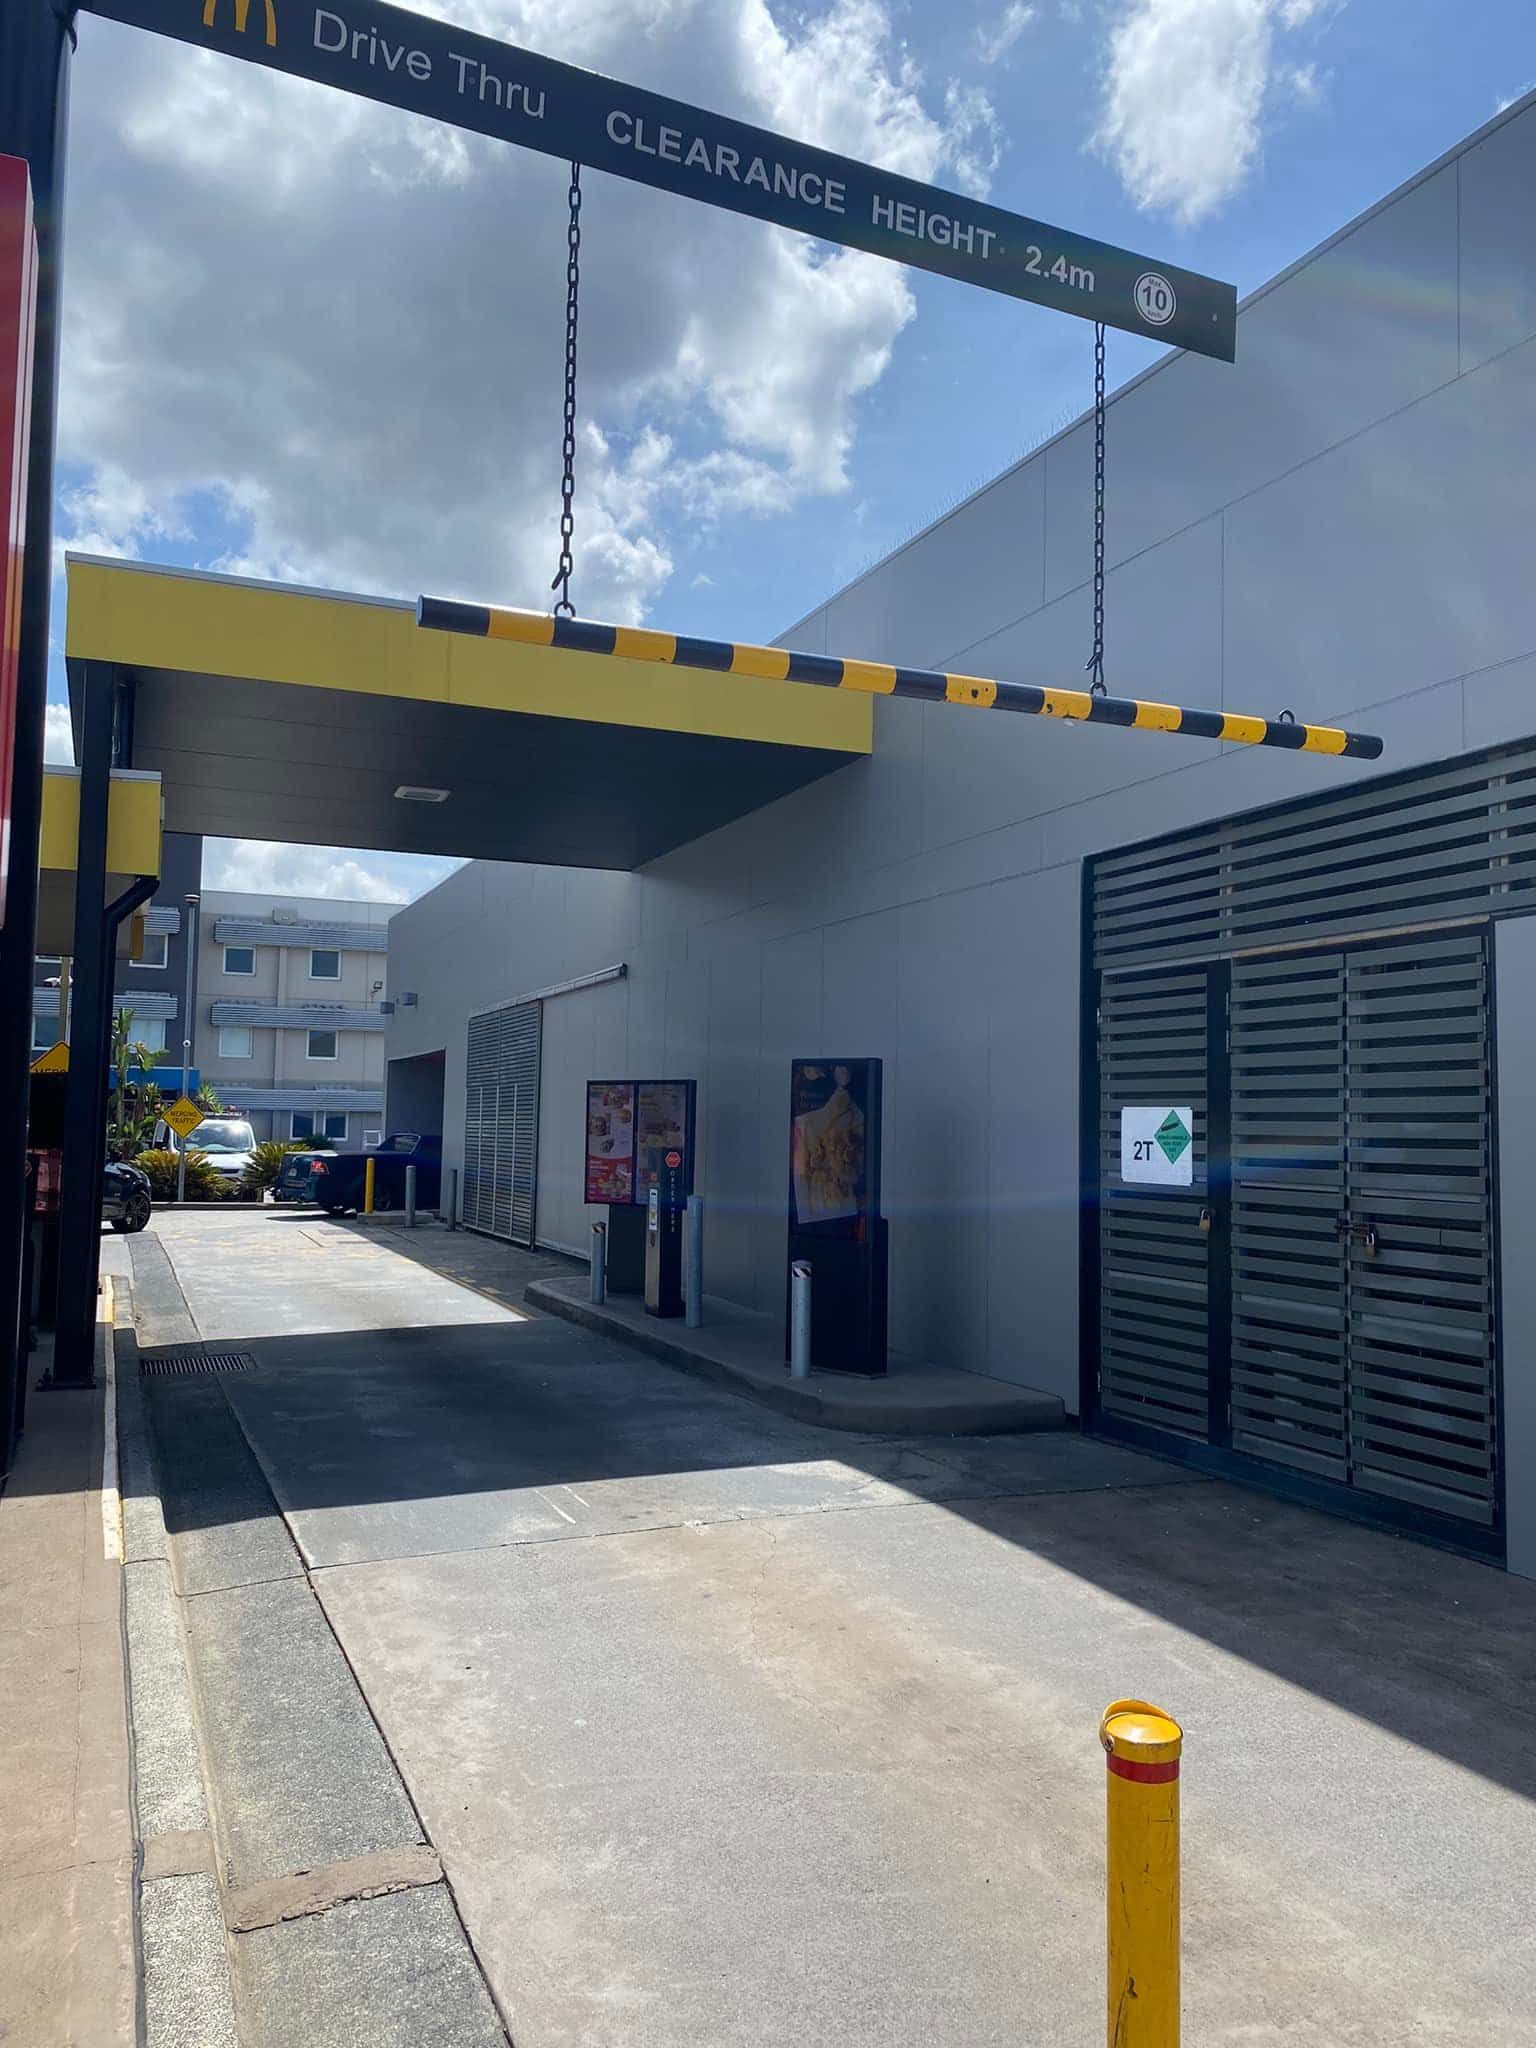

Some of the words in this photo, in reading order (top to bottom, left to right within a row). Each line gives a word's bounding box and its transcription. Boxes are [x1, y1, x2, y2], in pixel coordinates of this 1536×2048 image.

[313, 9, 433, 81] Drive
[448, 53, 546, 119] Thru
[605, 110, 847, 214] CLEARANCE
[871, 196, 997, 259] HEIGHT
[1023, 245, 1095, 293] 2.4m
[1143, 286, 1167, 310] 10
[172, 1117, 196, 1125] TRAFFIC
[1133, 1141, 1154, 1161] 2T
